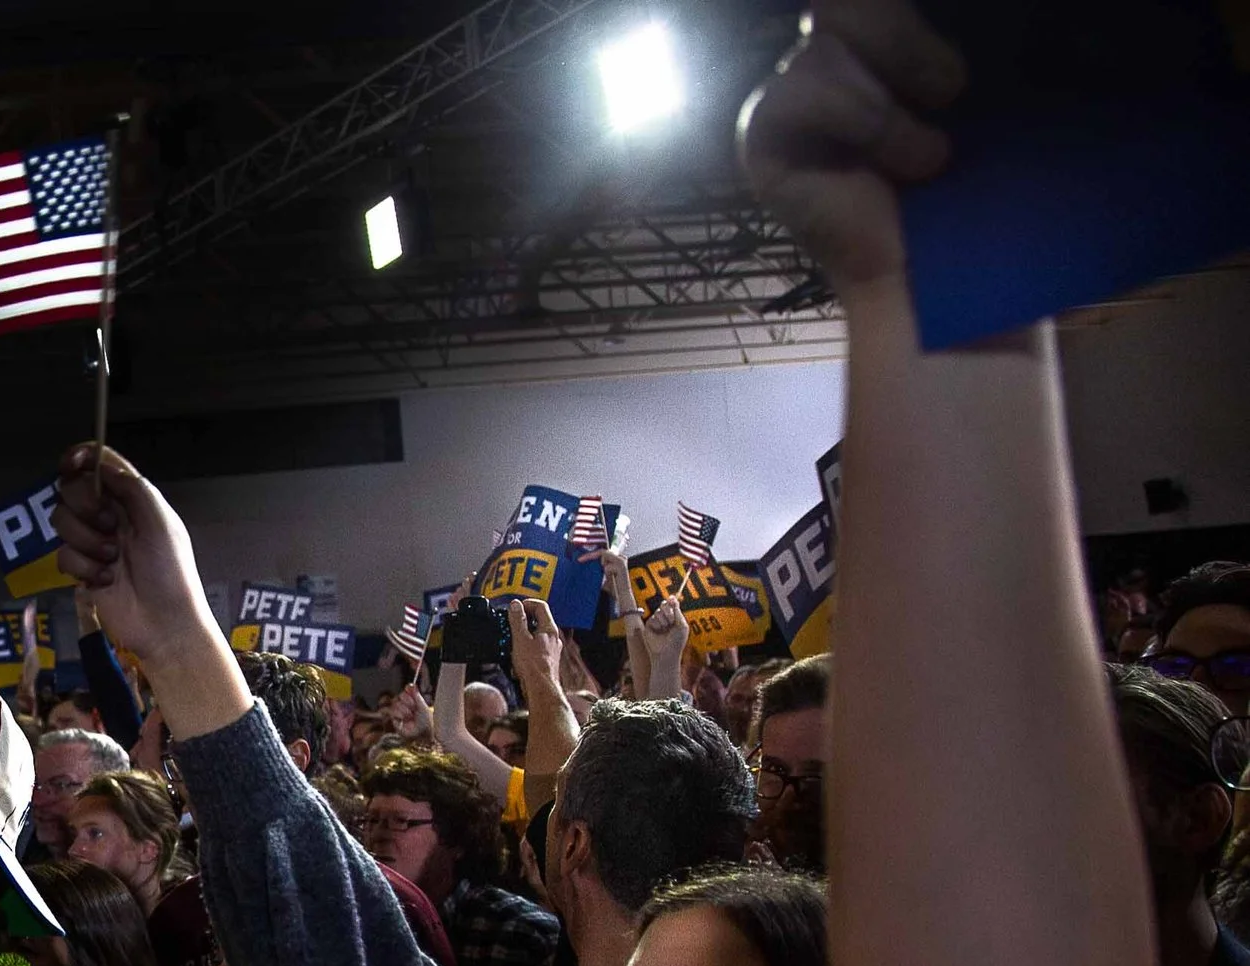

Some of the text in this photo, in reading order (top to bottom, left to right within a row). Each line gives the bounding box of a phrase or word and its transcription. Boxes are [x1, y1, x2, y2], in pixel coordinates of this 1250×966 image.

[516, 495, 578, 537] EN
[630, 555, 728, 617] PETE
[766, 514, 837, 623] PE
[262, 622, 350, 667] PETE
